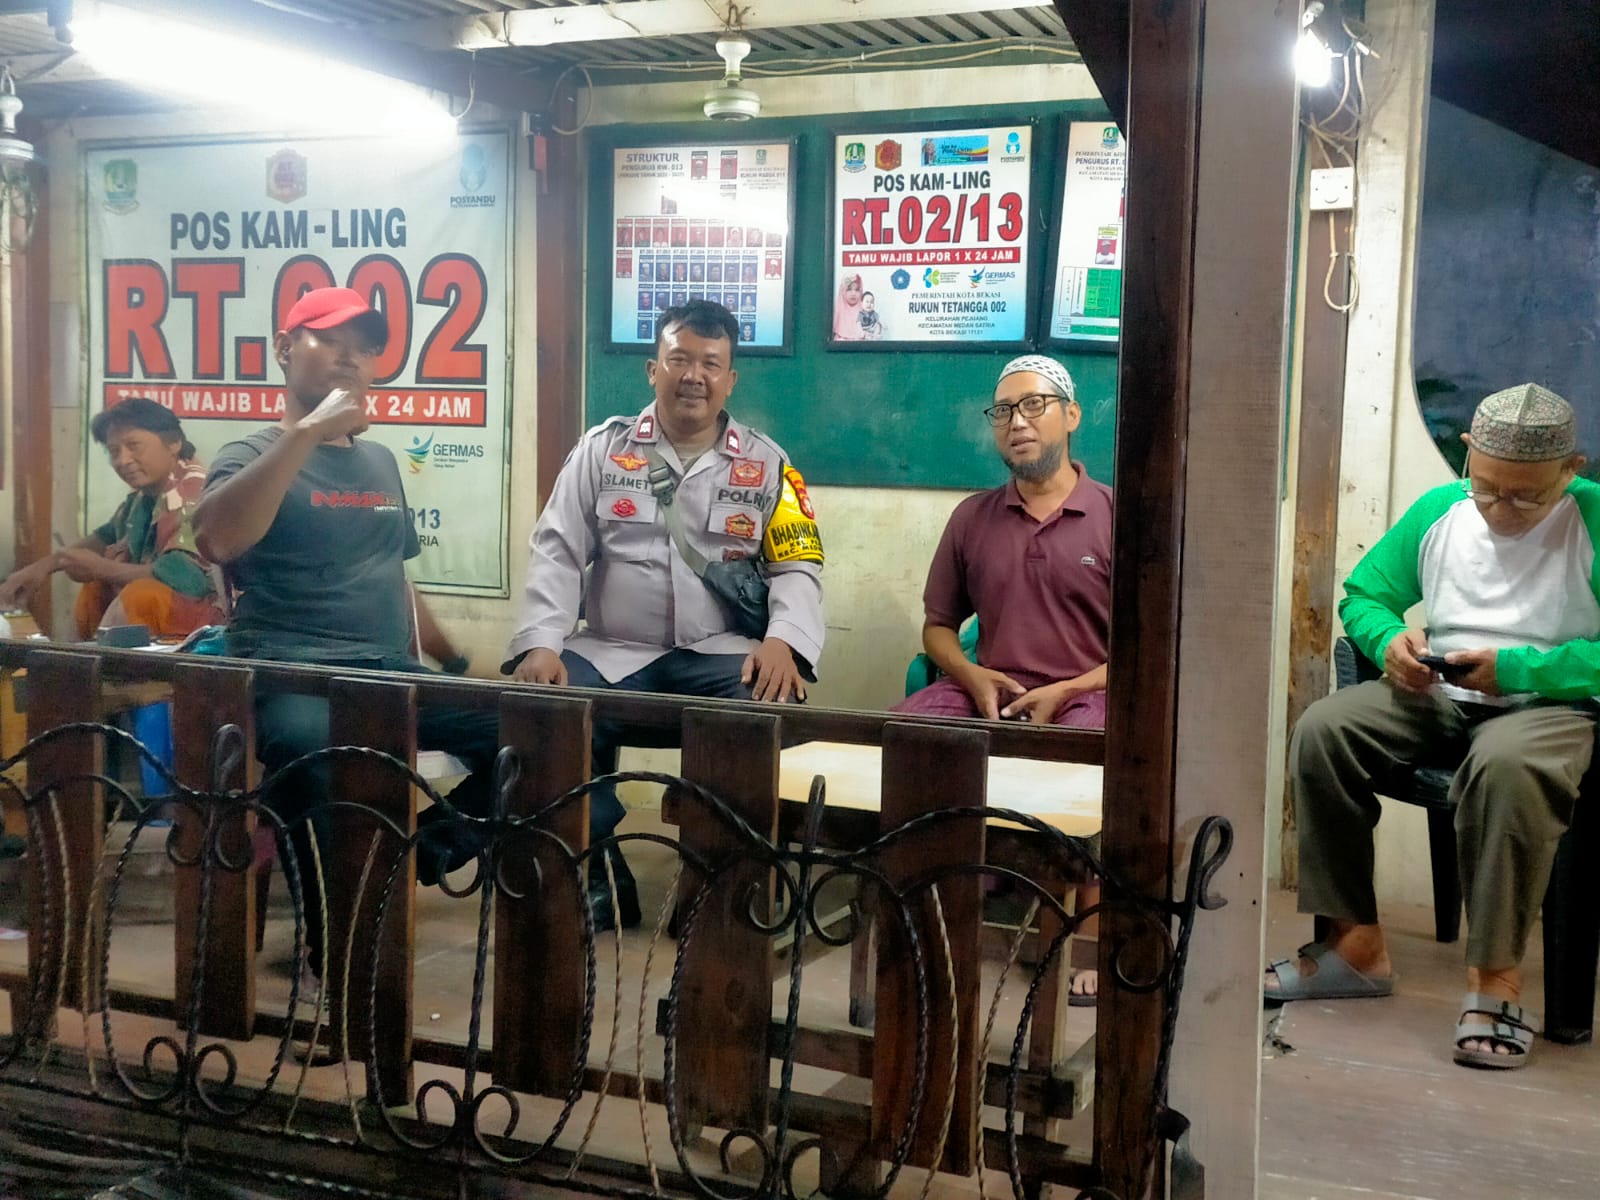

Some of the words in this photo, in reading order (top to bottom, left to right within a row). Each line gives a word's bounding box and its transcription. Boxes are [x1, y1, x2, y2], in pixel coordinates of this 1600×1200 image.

[626, 152, 680, 163] STRUKTUR
[1075, 157, 1110, 165] PENGURUS
[874, 174, 905, 192] POS
[910, 170, 991, 191] KAM-LING
[842, 192, 1023, 245] RT.02/13
[170, 211, 231, 250] POS
[849, 252, 877, 263] TAMU
[880, 252, 913, 263] WAJIB
[916, 251, 951, 262] LAPOR
[954, 251, 960, 262] 1
[964, 251, 972, 261] X
[975, 251, 988, 261] 24
[991, 250, 1013, 261] JAM
[985, 271, 1016, 280] GERMAS
[909, 302, 940, 313] RUKUN
[941, 301, 988, 313] TETANGGA
[990, 301, 1007, 312] 002
[182, 391, 252, 414] WAJIB
[364, 394, 379, 417] X
[387, 396, 415, 417] 24
[423, 396, 472, 419] JAM
[432, 444, 485, 458] GERMAS
[603, 473, 650, 490] SLAMET
